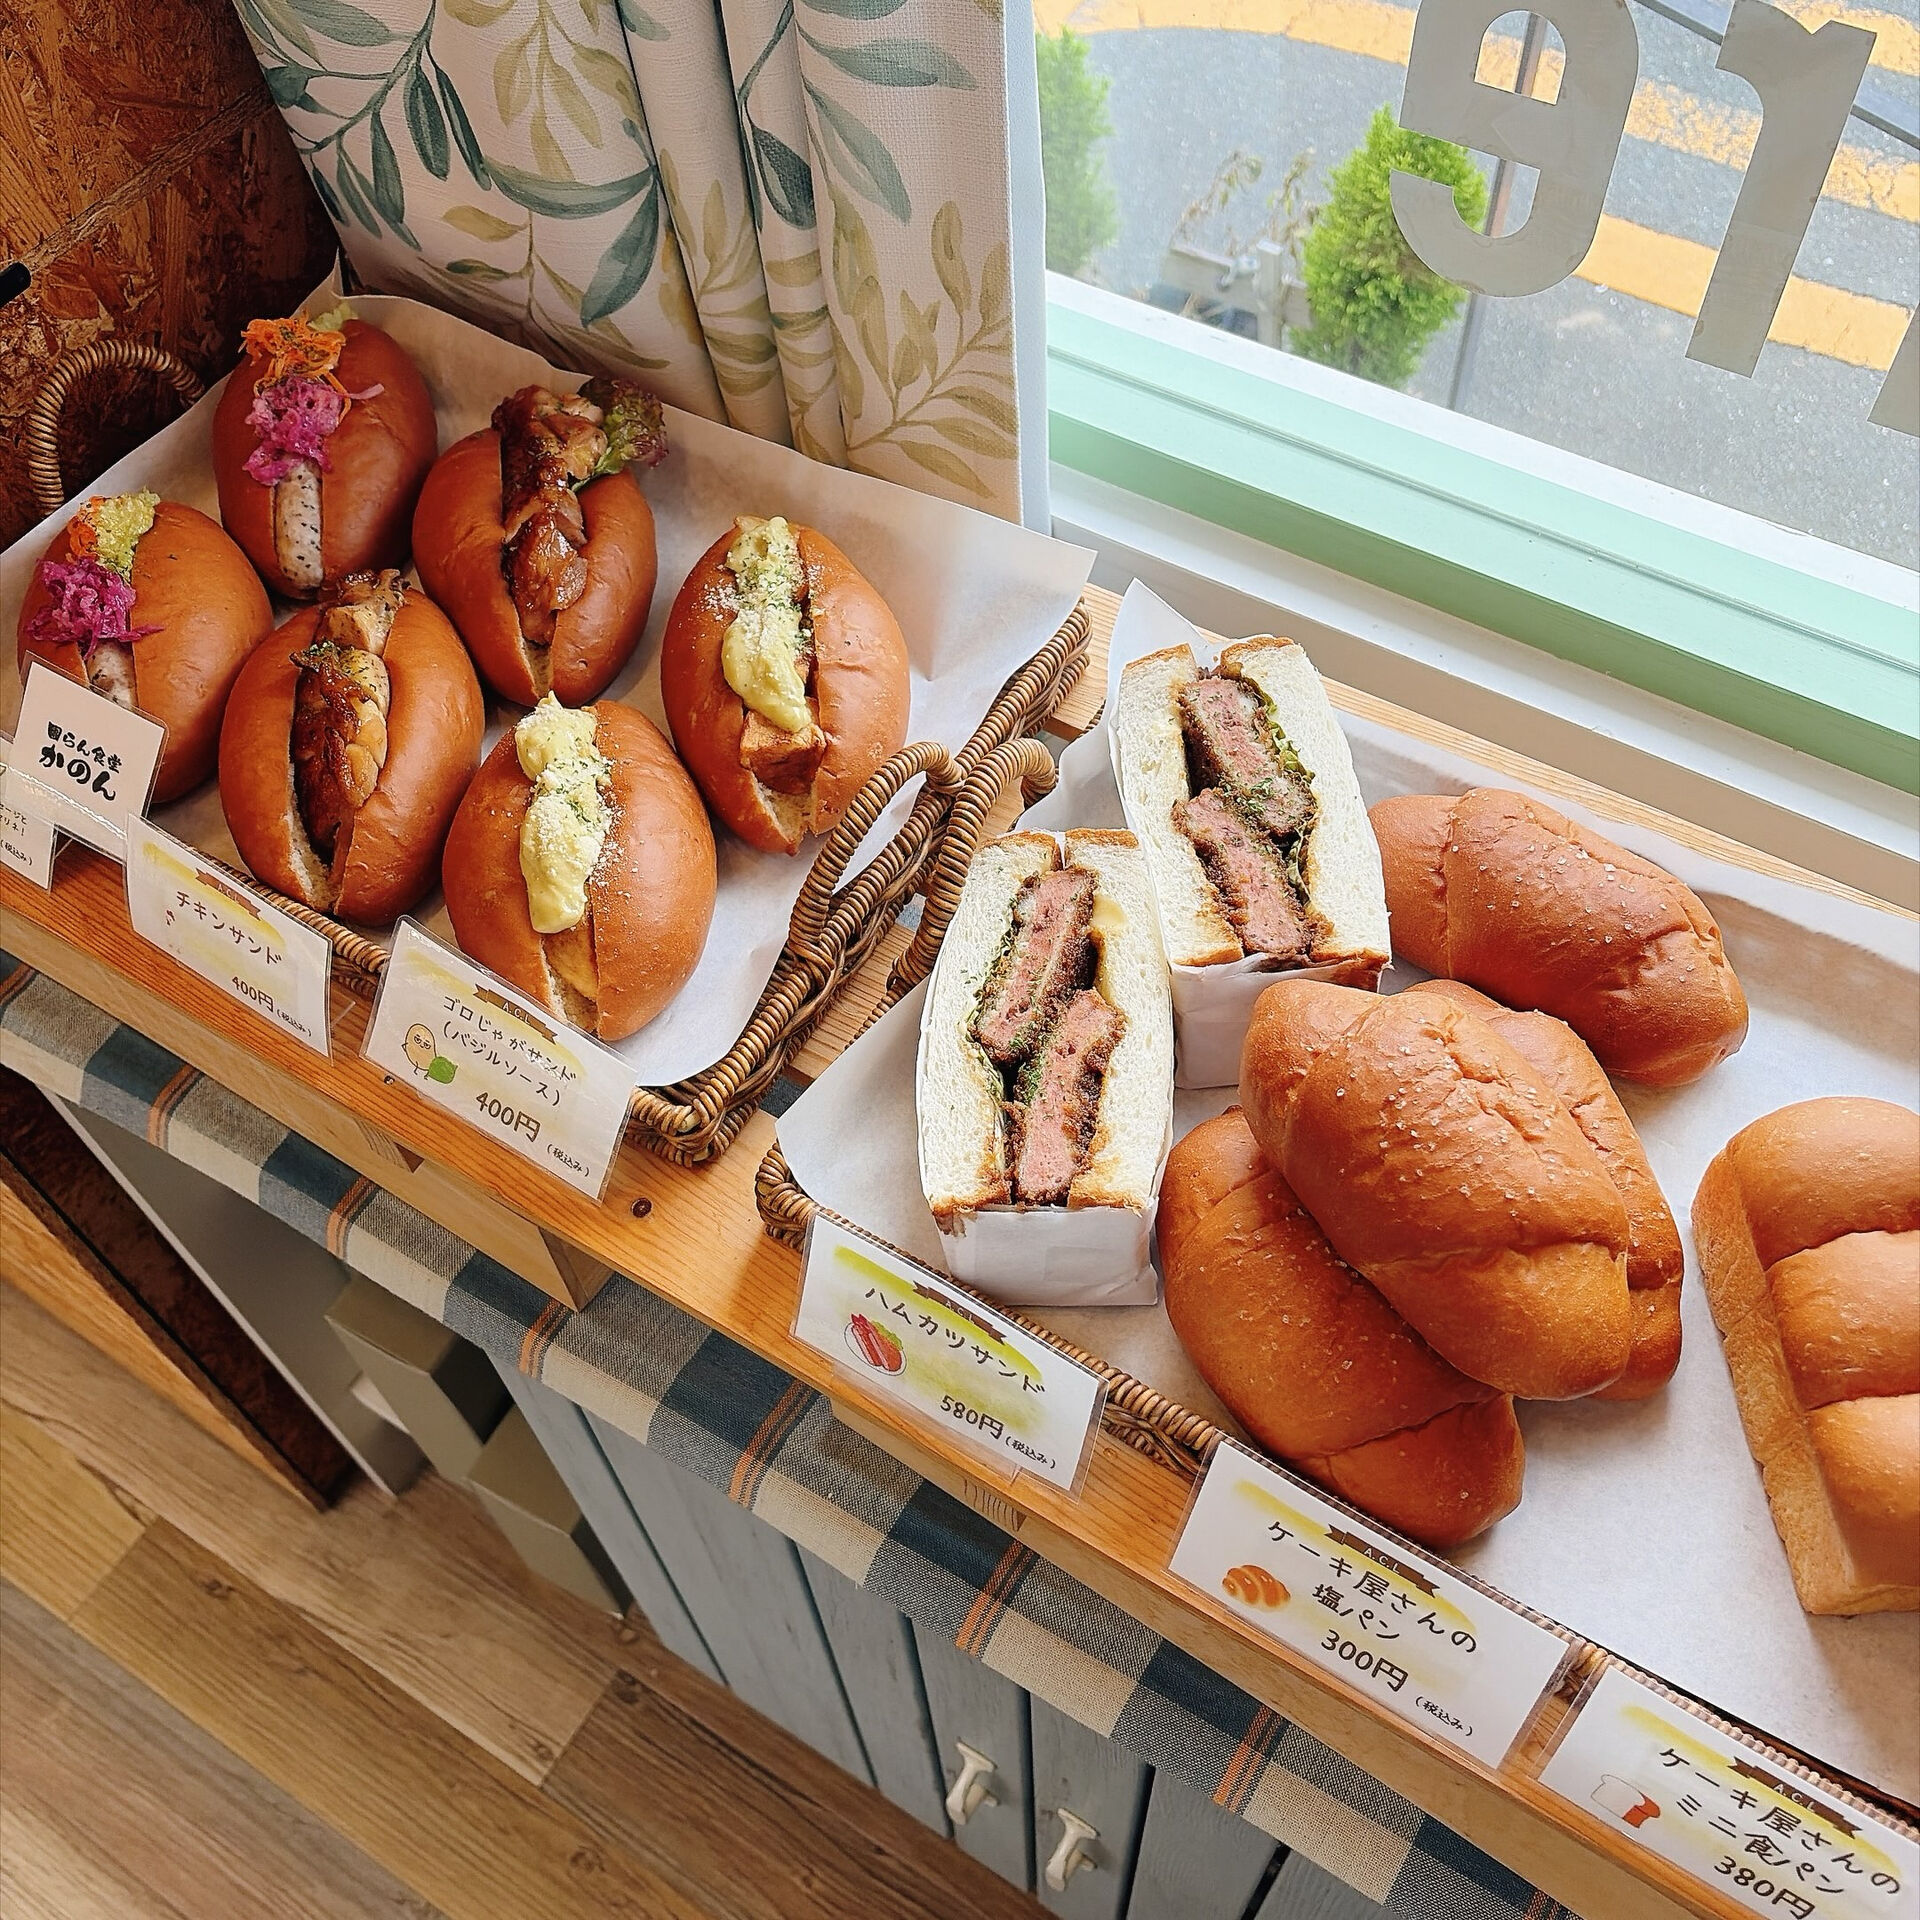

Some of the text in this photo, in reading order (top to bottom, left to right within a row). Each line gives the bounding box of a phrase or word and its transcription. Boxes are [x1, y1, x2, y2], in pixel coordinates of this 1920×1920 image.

[39, 744, 116, 801] かのん
[176, 890, 282, 964] チキンサンド
[231, 976, 274, 1013] 400円
[443, 995, 576, 1081] ゴロじゃがサンド
[443, 1020, 560, 1106] （バジルソース）
[475, 1091, 541, 1143] 400円
[865, 1288, 1045, 1393] ハムカツサンド
[939, 1395, 1004, 1440] 580円
[1268, 1521, 1477, 1653] ケーキ屋さんの
[1312, 1583, 1400, 1640] 塩パン
[1320, 1629, 1409, 1692] 300円
[1659, 1747, 1901, 1894] ケーキ屋さんの
[1676, 1794, 1844, 1893] ミニ食パン
[1713, 1855, 1815, 1920] 380円
